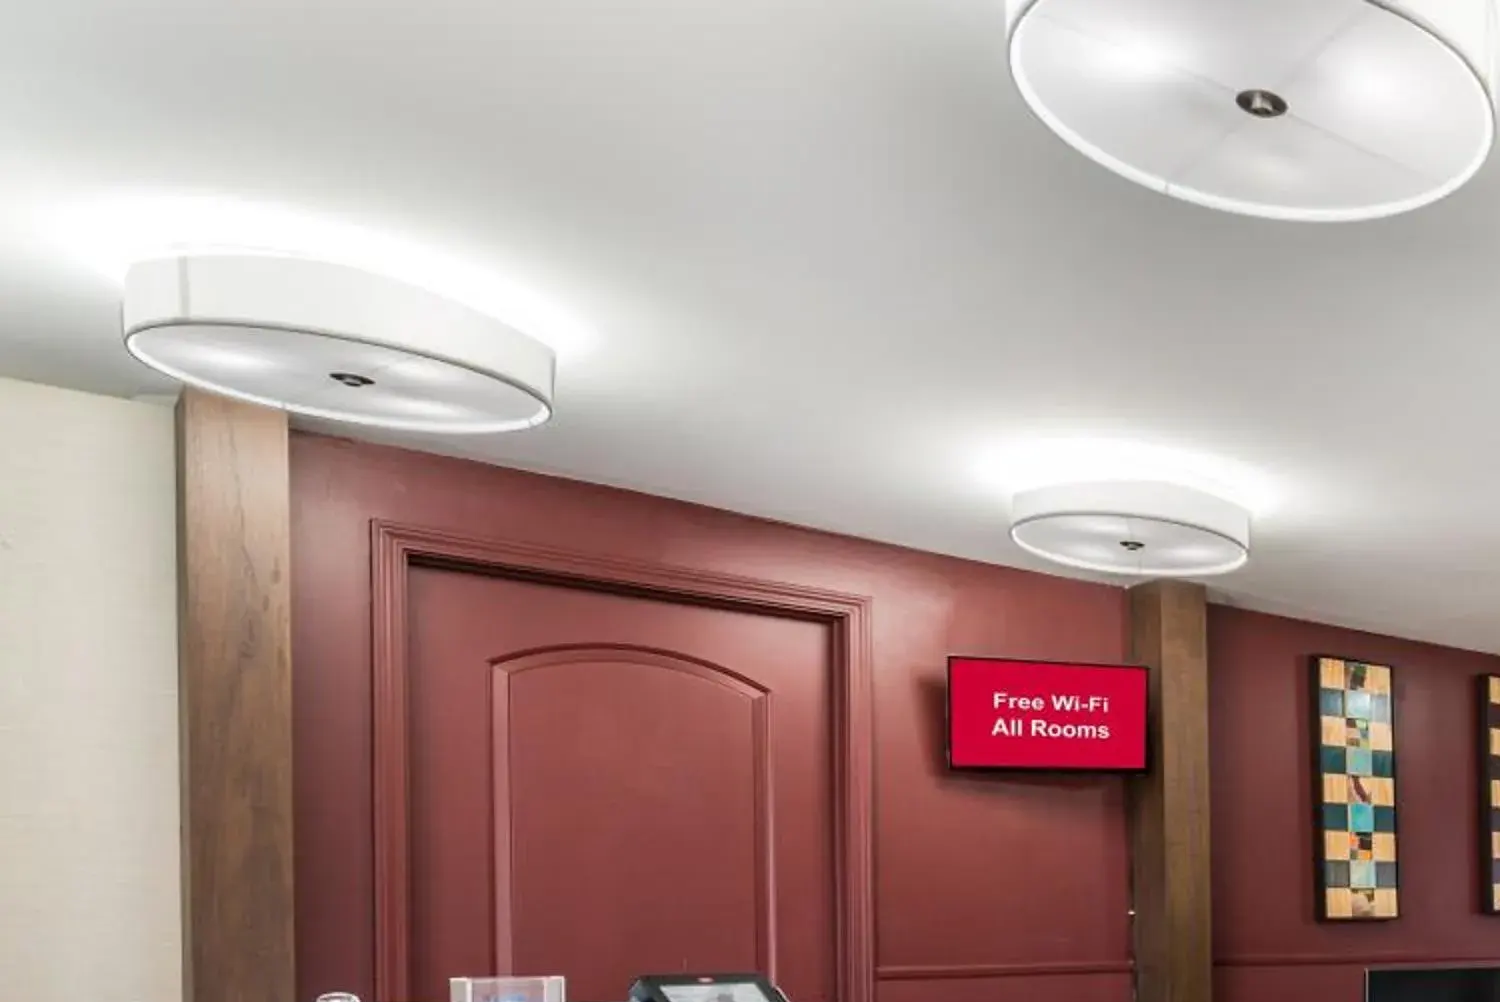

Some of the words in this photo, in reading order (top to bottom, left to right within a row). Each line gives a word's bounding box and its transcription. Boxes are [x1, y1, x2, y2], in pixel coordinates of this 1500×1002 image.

[993, 691, 1045, 710] Free
[1051, 694, 1109, 712] Wi-Fi
[991, 717, 1023, 737] All
[1030, 719, 1110, 739] Rooms
